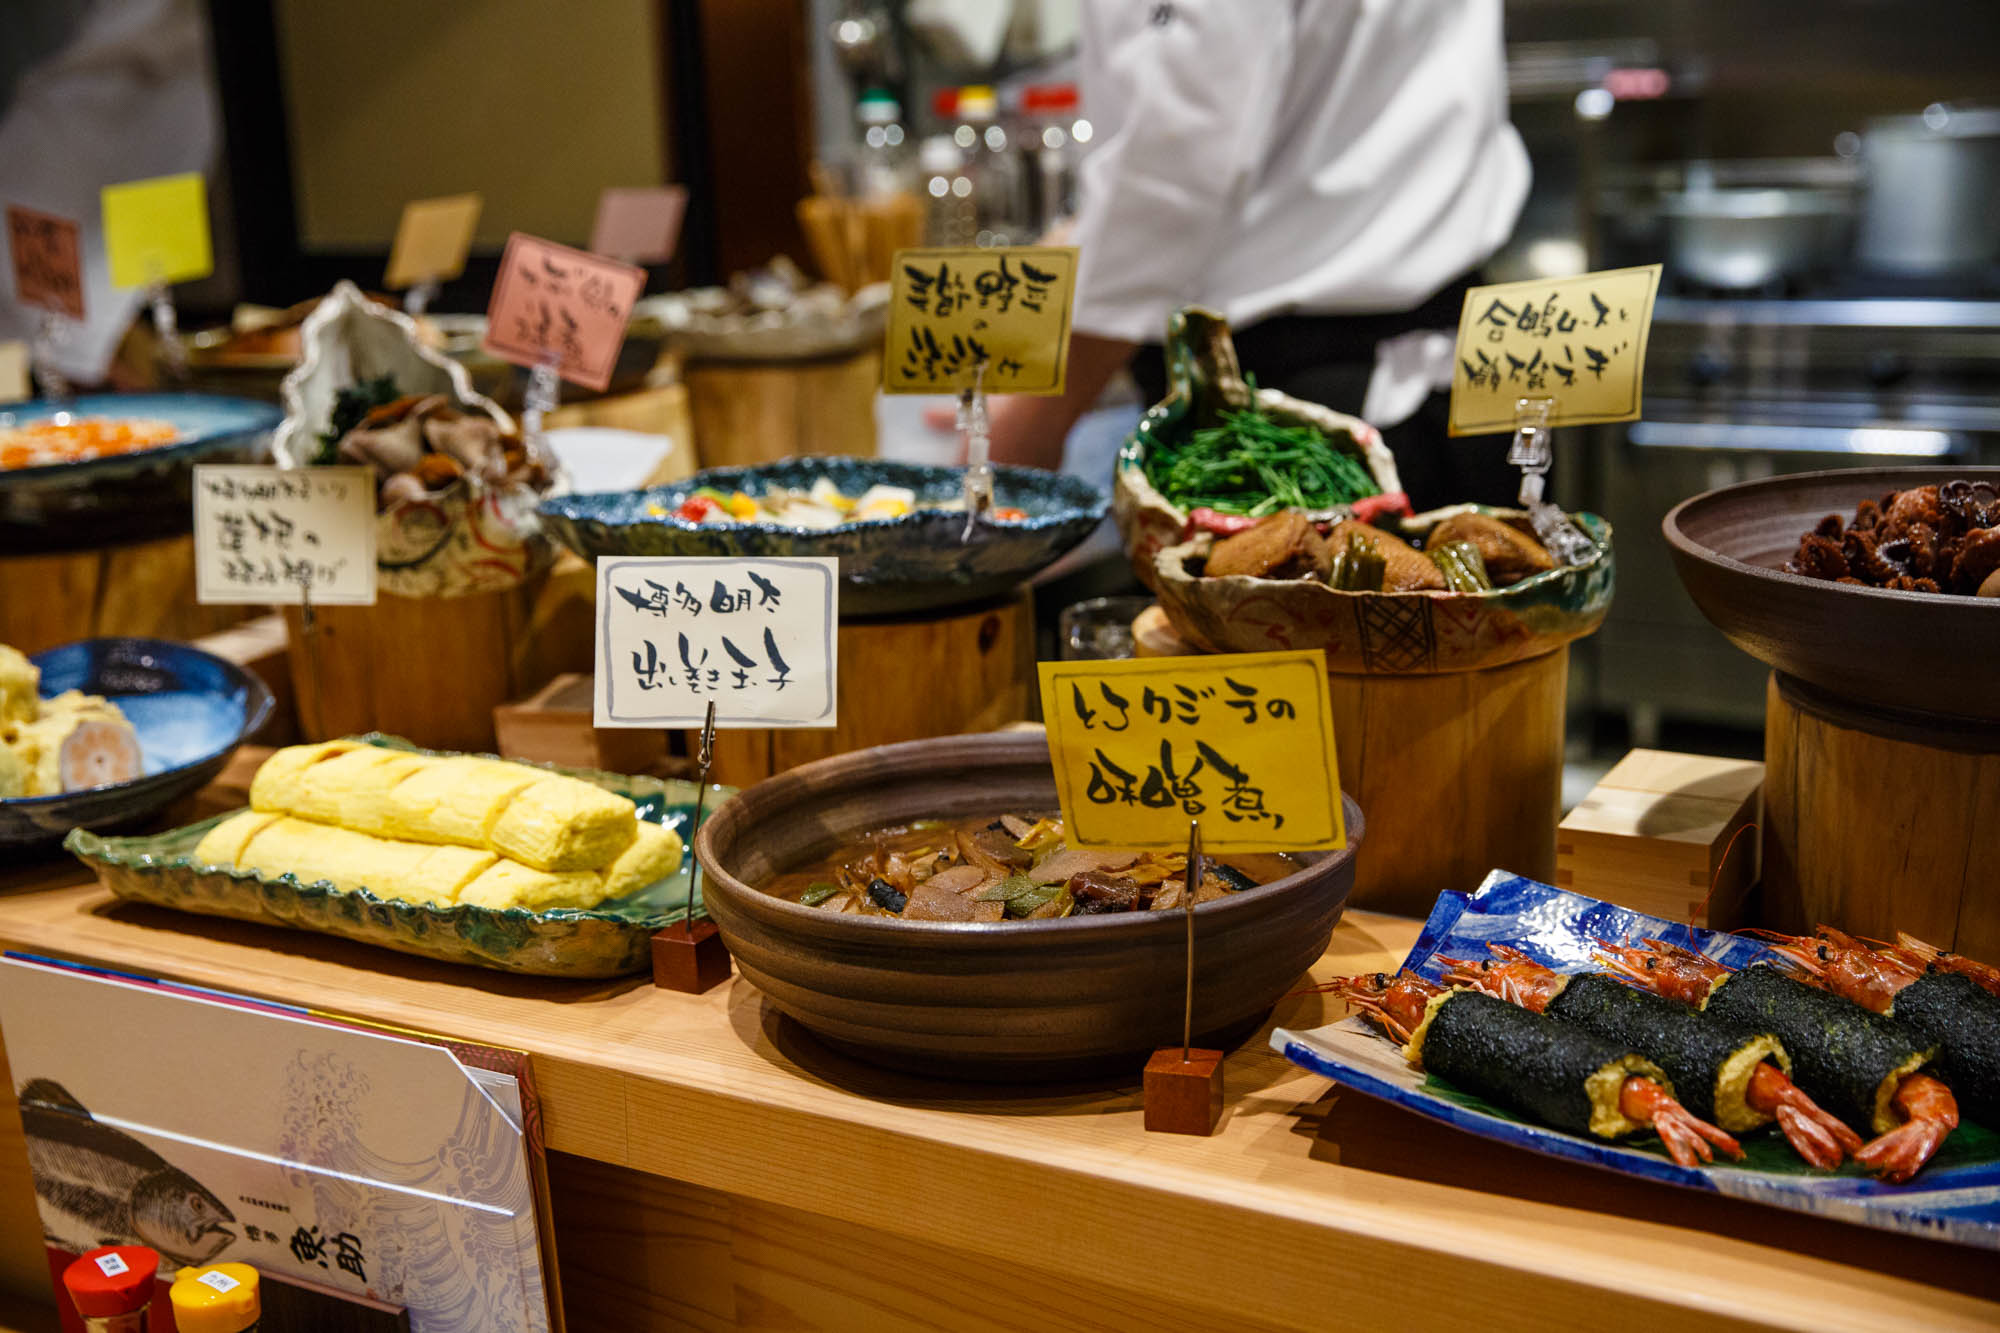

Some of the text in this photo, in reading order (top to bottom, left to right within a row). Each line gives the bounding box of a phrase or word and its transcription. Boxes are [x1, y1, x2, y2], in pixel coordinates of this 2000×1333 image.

[615, 570, 781, 618] 博多明太
[1072, 677, 1296, 731] とろクジラの
[1086, 738, 1285, 830] 味噌煮
